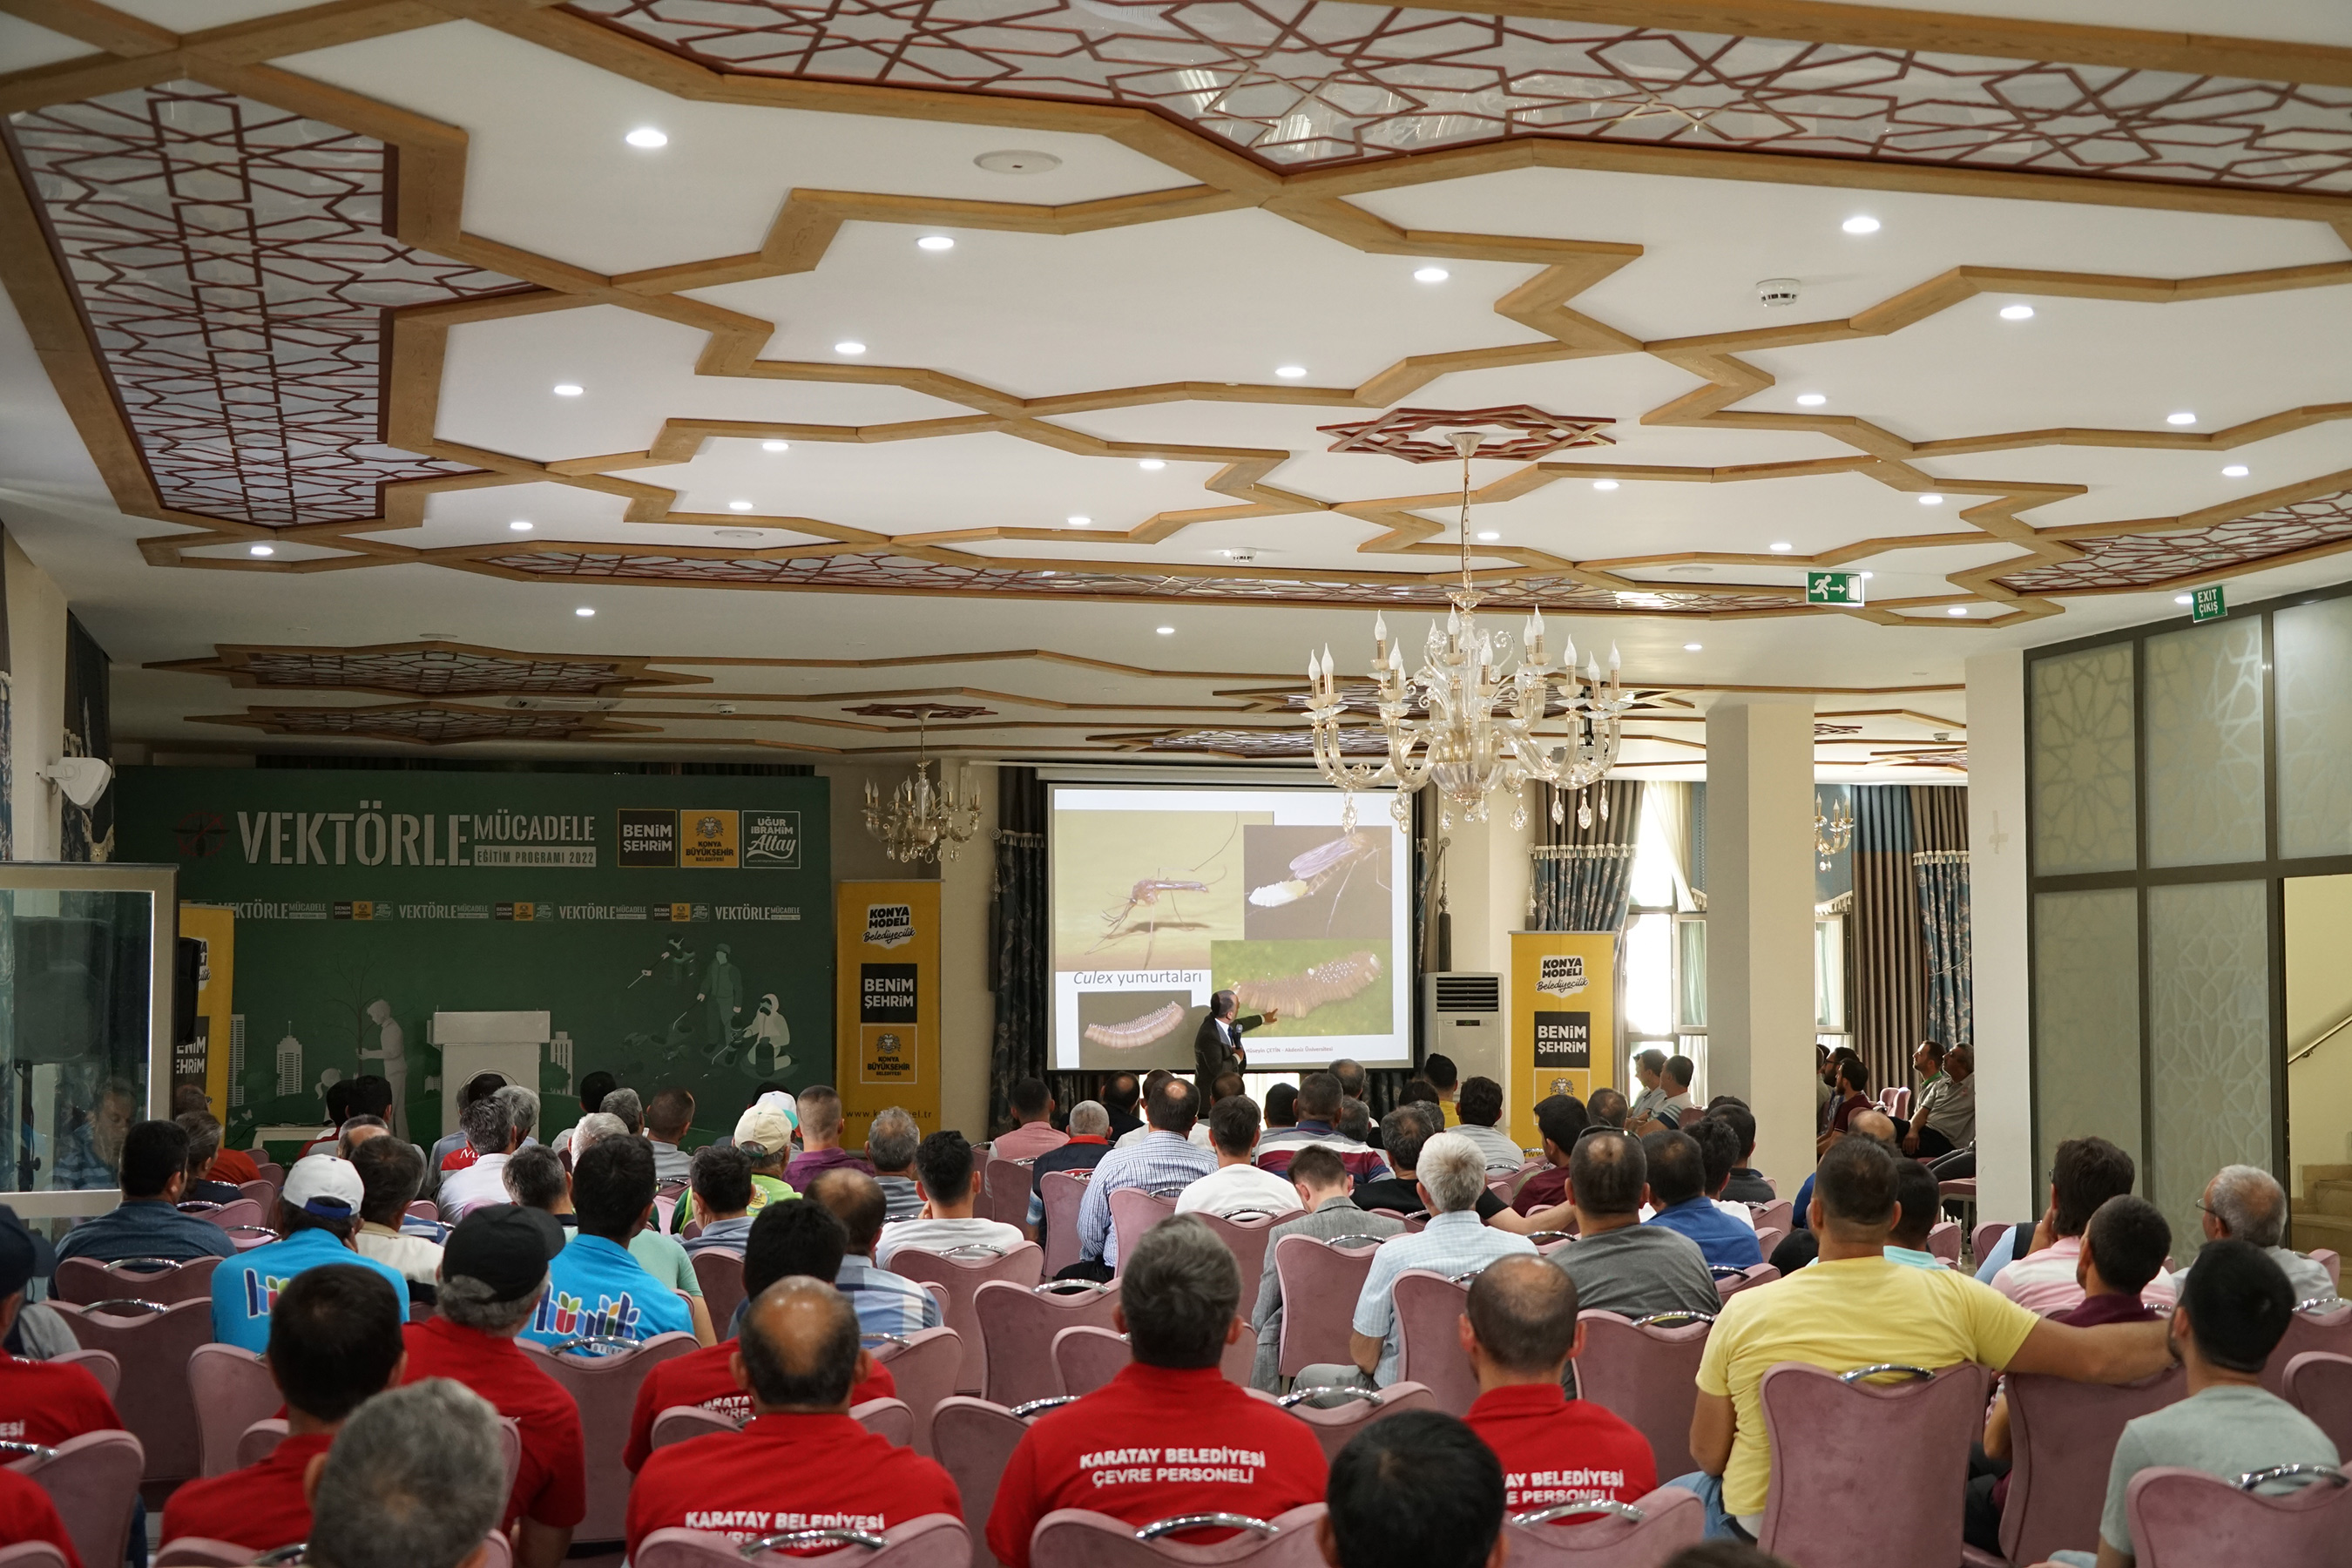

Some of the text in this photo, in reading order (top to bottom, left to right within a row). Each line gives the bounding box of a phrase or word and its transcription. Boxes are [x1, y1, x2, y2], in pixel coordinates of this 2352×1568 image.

[2197, 589, 2217, 603] EXIT
[2199, 601, 2219, 617] ÇIKIŞ
[757, 815, 787, 828] UĞUR
[237, 800, 596, 866] VEKTÖRLE MÜCADELE
[747, 834, 797, 860] Altay
[477, 849, 594, 863] EĞİTİM PROGRAMI 2022
[288, 901, 327, 912] MÜCADELE
[399, 902, 457, 919] VEKTÖRLE
[559, 903, 616, 920] VEKTÖRLE
[715, 903, 770, 920] VEKTÖRLE
[869, 906, 909, 919] KONYA
[863, 926, 916, 944] Belediyecilik
[1543, 957, 1582, 970] KONYA
[1073, 970, 1202, 987] Culex yumurtaları
[1536, 977, 1589, 994] Belediyecilik
[1079, 1445, 1266, 1470] KARATAY BELEDİYESİ
[1092, 1467, 1254, 1489] ÇEVRE PERSONELİ
[1531, 1466, 1625, 1488] BELEDİYESİ
[685, 1511, 885, 1531] KARATAY BELEDİYESİ
